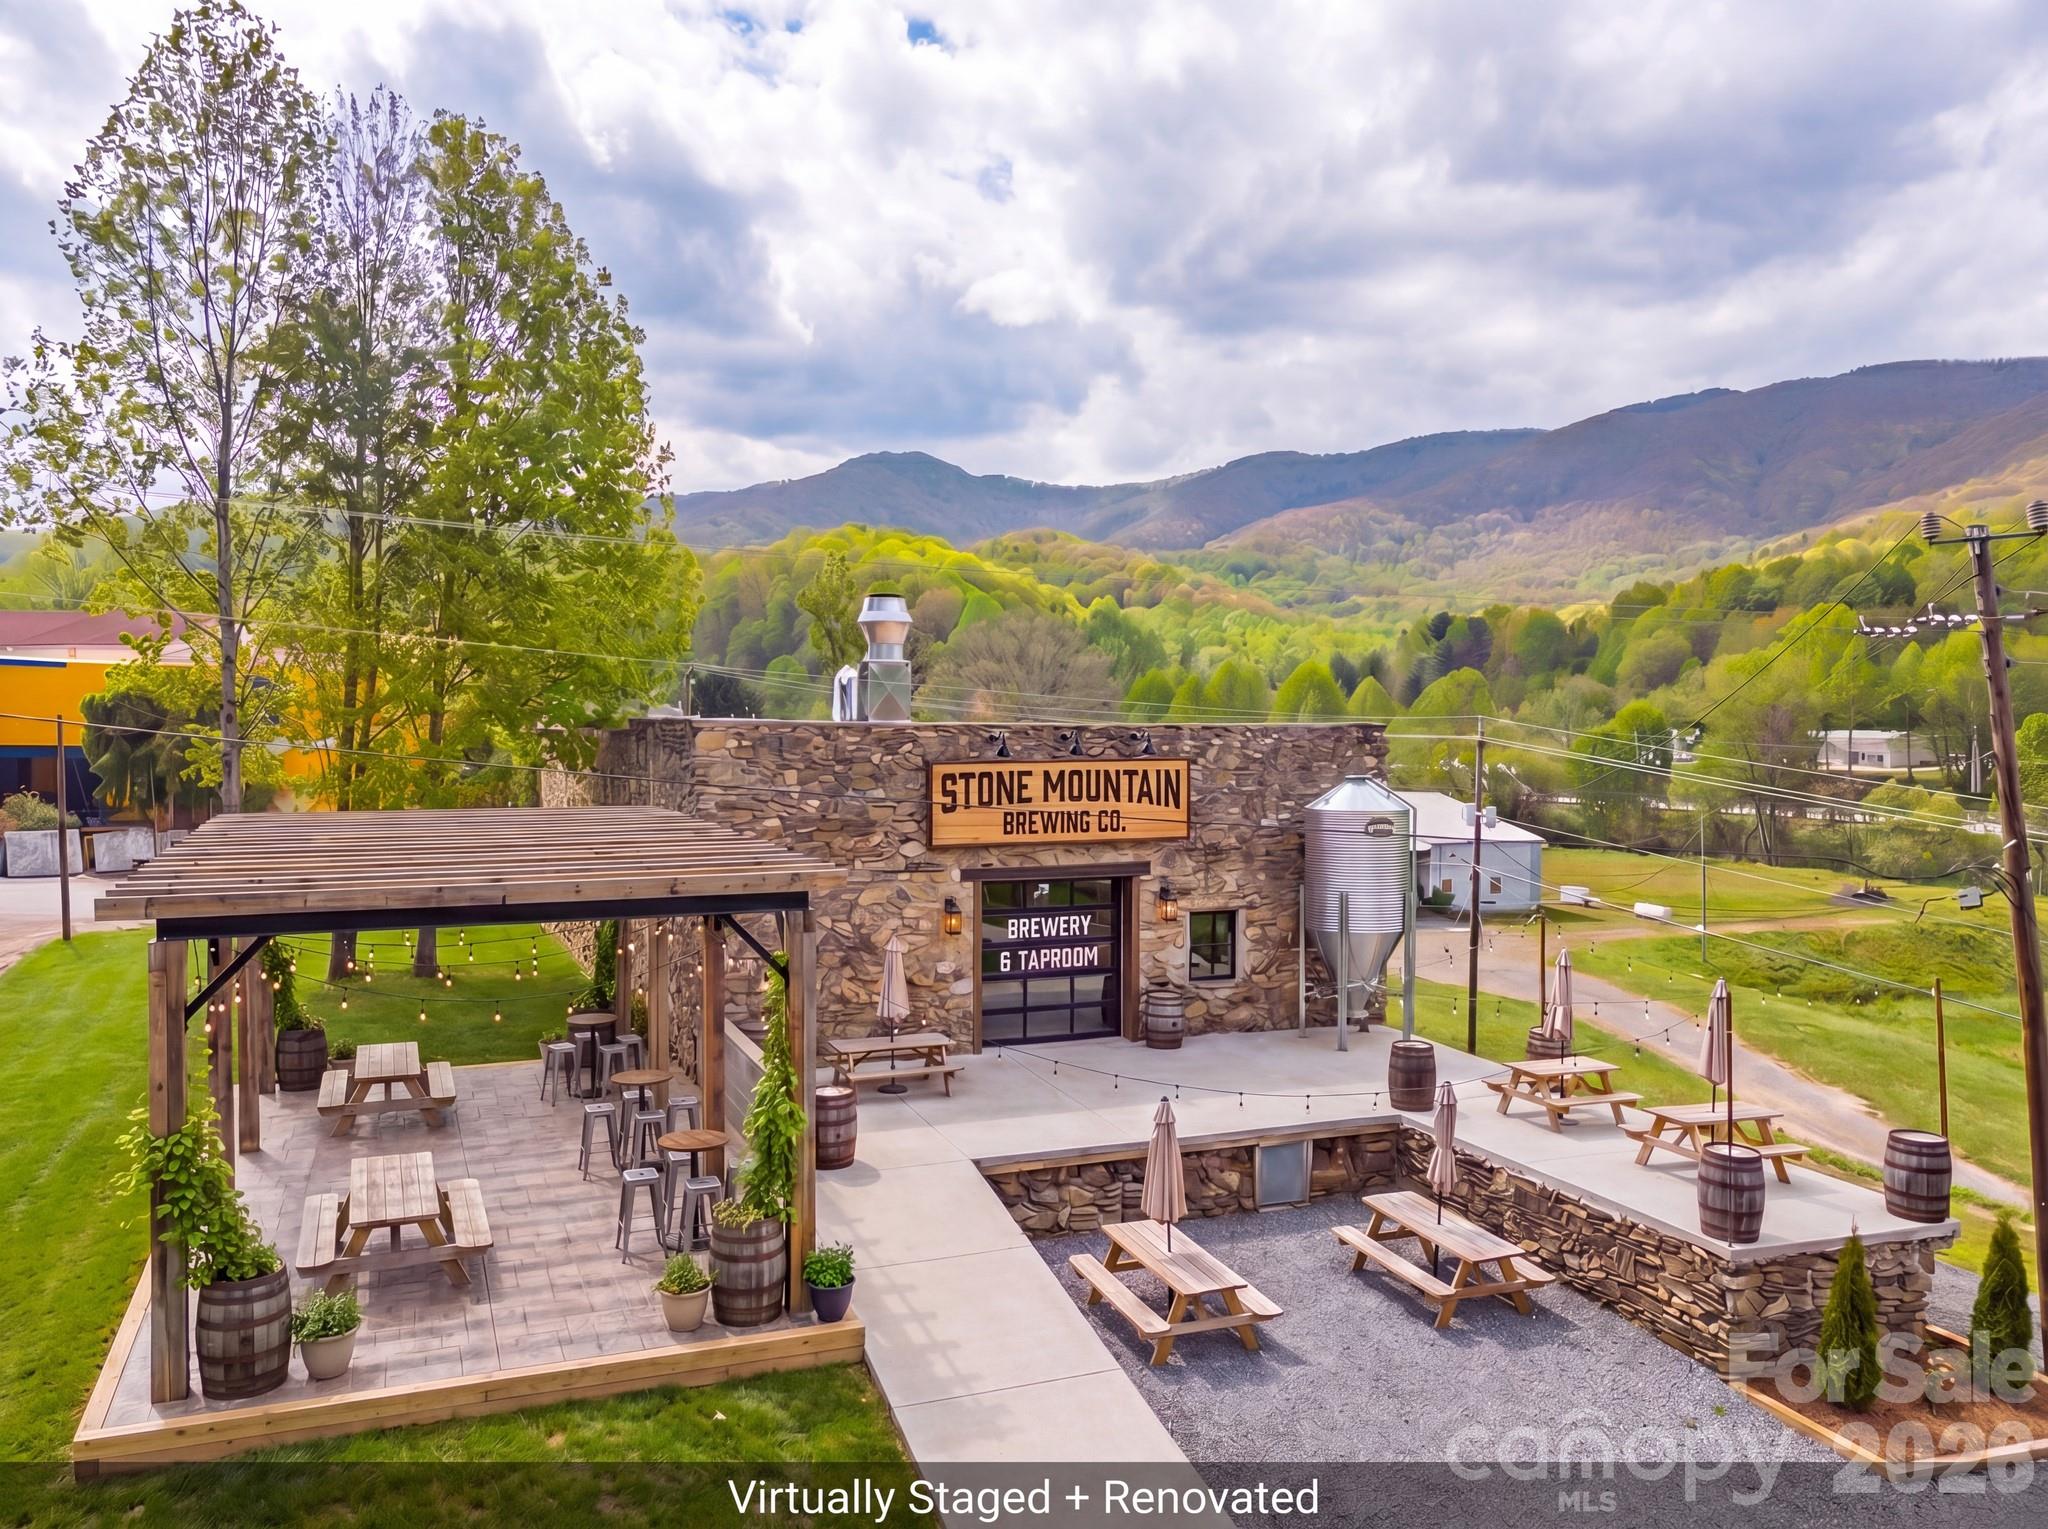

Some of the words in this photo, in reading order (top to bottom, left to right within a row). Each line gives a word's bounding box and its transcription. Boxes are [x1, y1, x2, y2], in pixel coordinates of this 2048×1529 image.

[940, 769, 1033, 814] STONE
[1043, 768, 1181, 809] MOUNTAIN
[1003, 810, 1090, 835] BREWING
[1098, 809, 1126, 833] CO.
[1007, 915, 1092, 939] BREWERY
[1018, 946, 1098, 971] TAPROOM
